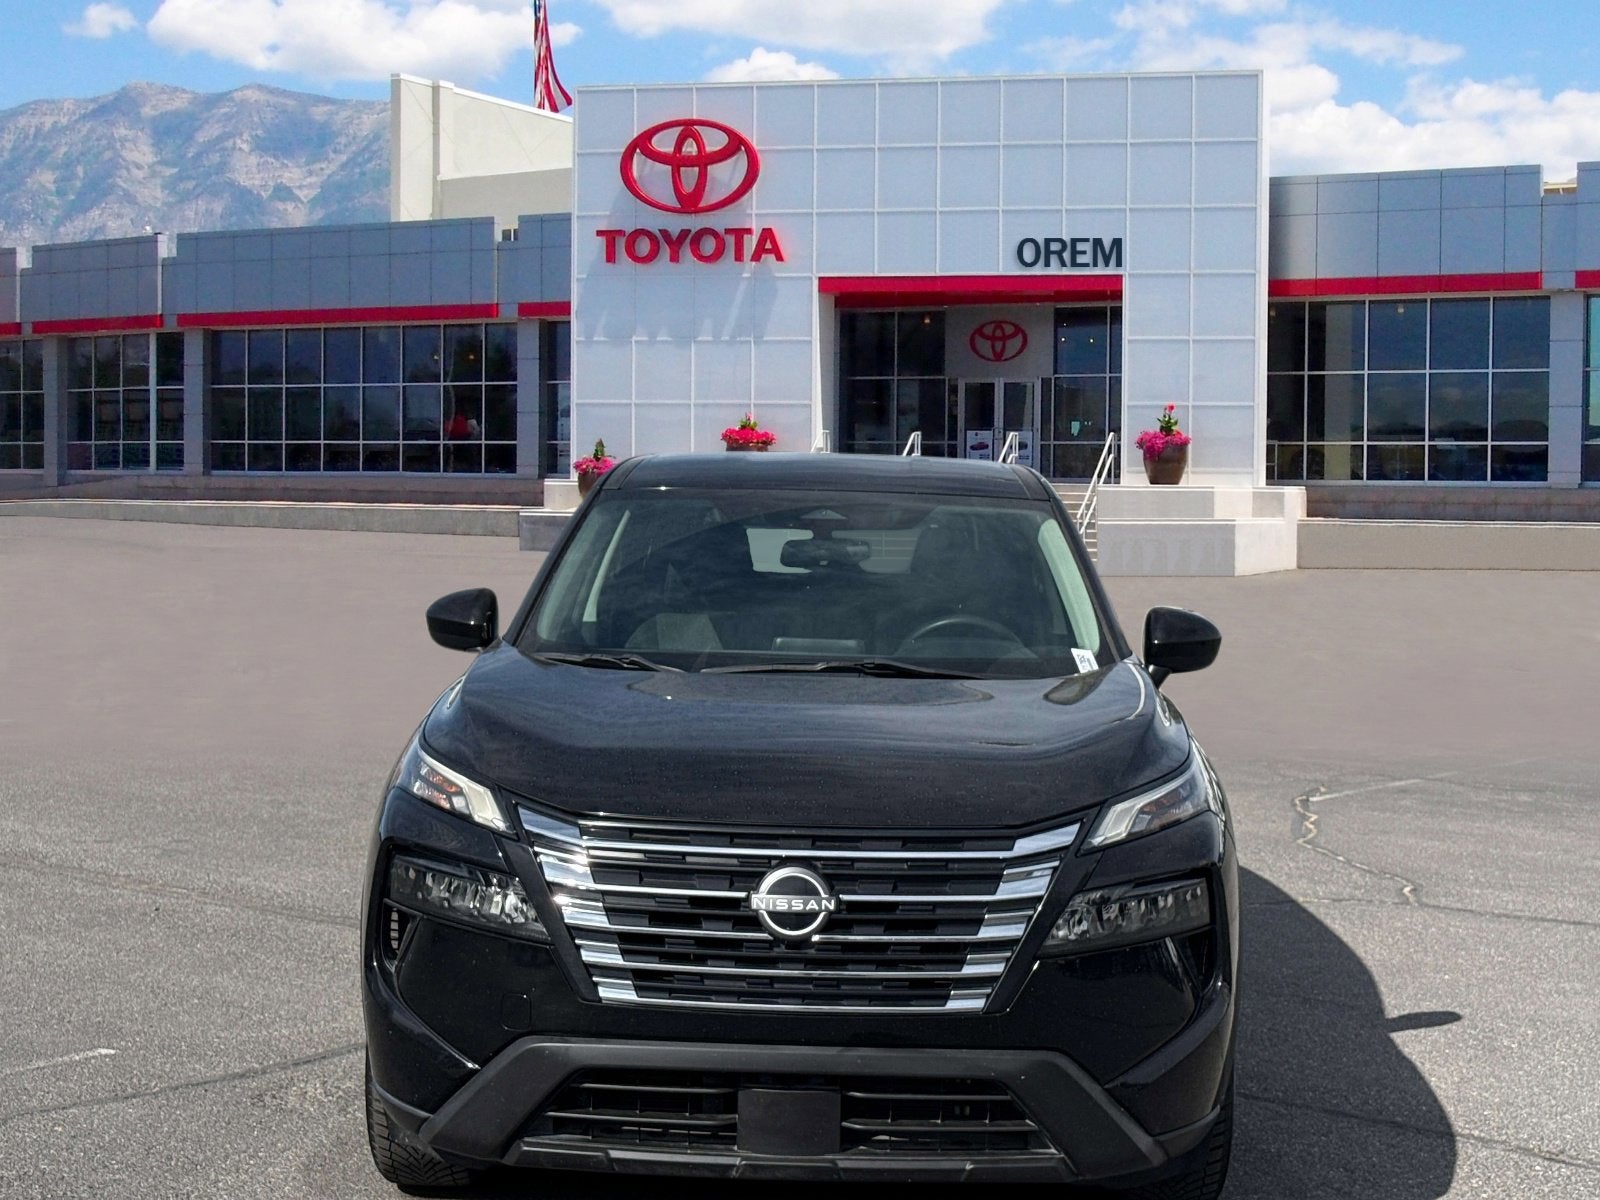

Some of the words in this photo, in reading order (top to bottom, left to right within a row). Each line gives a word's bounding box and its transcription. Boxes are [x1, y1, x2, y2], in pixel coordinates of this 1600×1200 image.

[596, 227, 784, 264] TOYOTA
[1017, 237, 1123, 268] OREM
[752, 897, 835, 911] NISSAN
